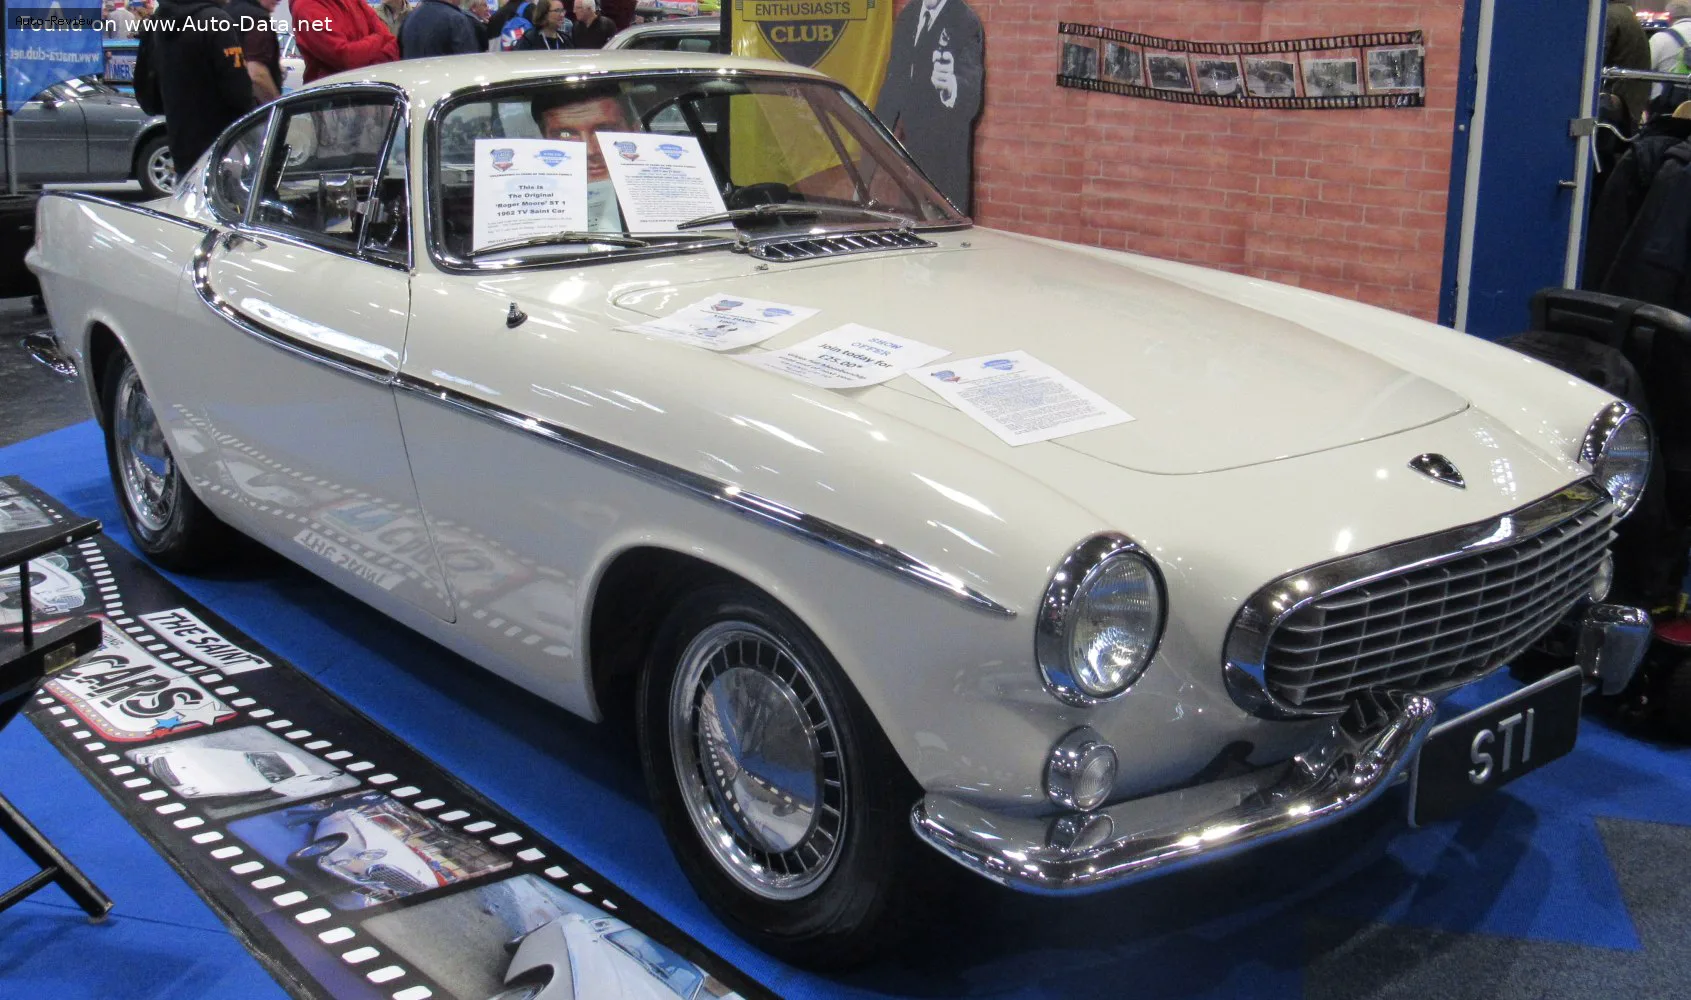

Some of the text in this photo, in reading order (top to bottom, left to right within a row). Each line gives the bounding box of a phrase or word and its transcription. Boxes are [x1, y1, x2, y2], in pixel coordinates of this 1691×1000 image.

[755, 2, 850, 16] ENTHUSIASTS
[770, 25, 834, 42] CLUB
[851, 342, 892, 357] OFFER
[869, 337, 904, 350] SHOW
[818, 343, 894, 369] Join today for
[148, 612, 265, 665] THE SAINT
[58, 654, 204, 719] CARS
